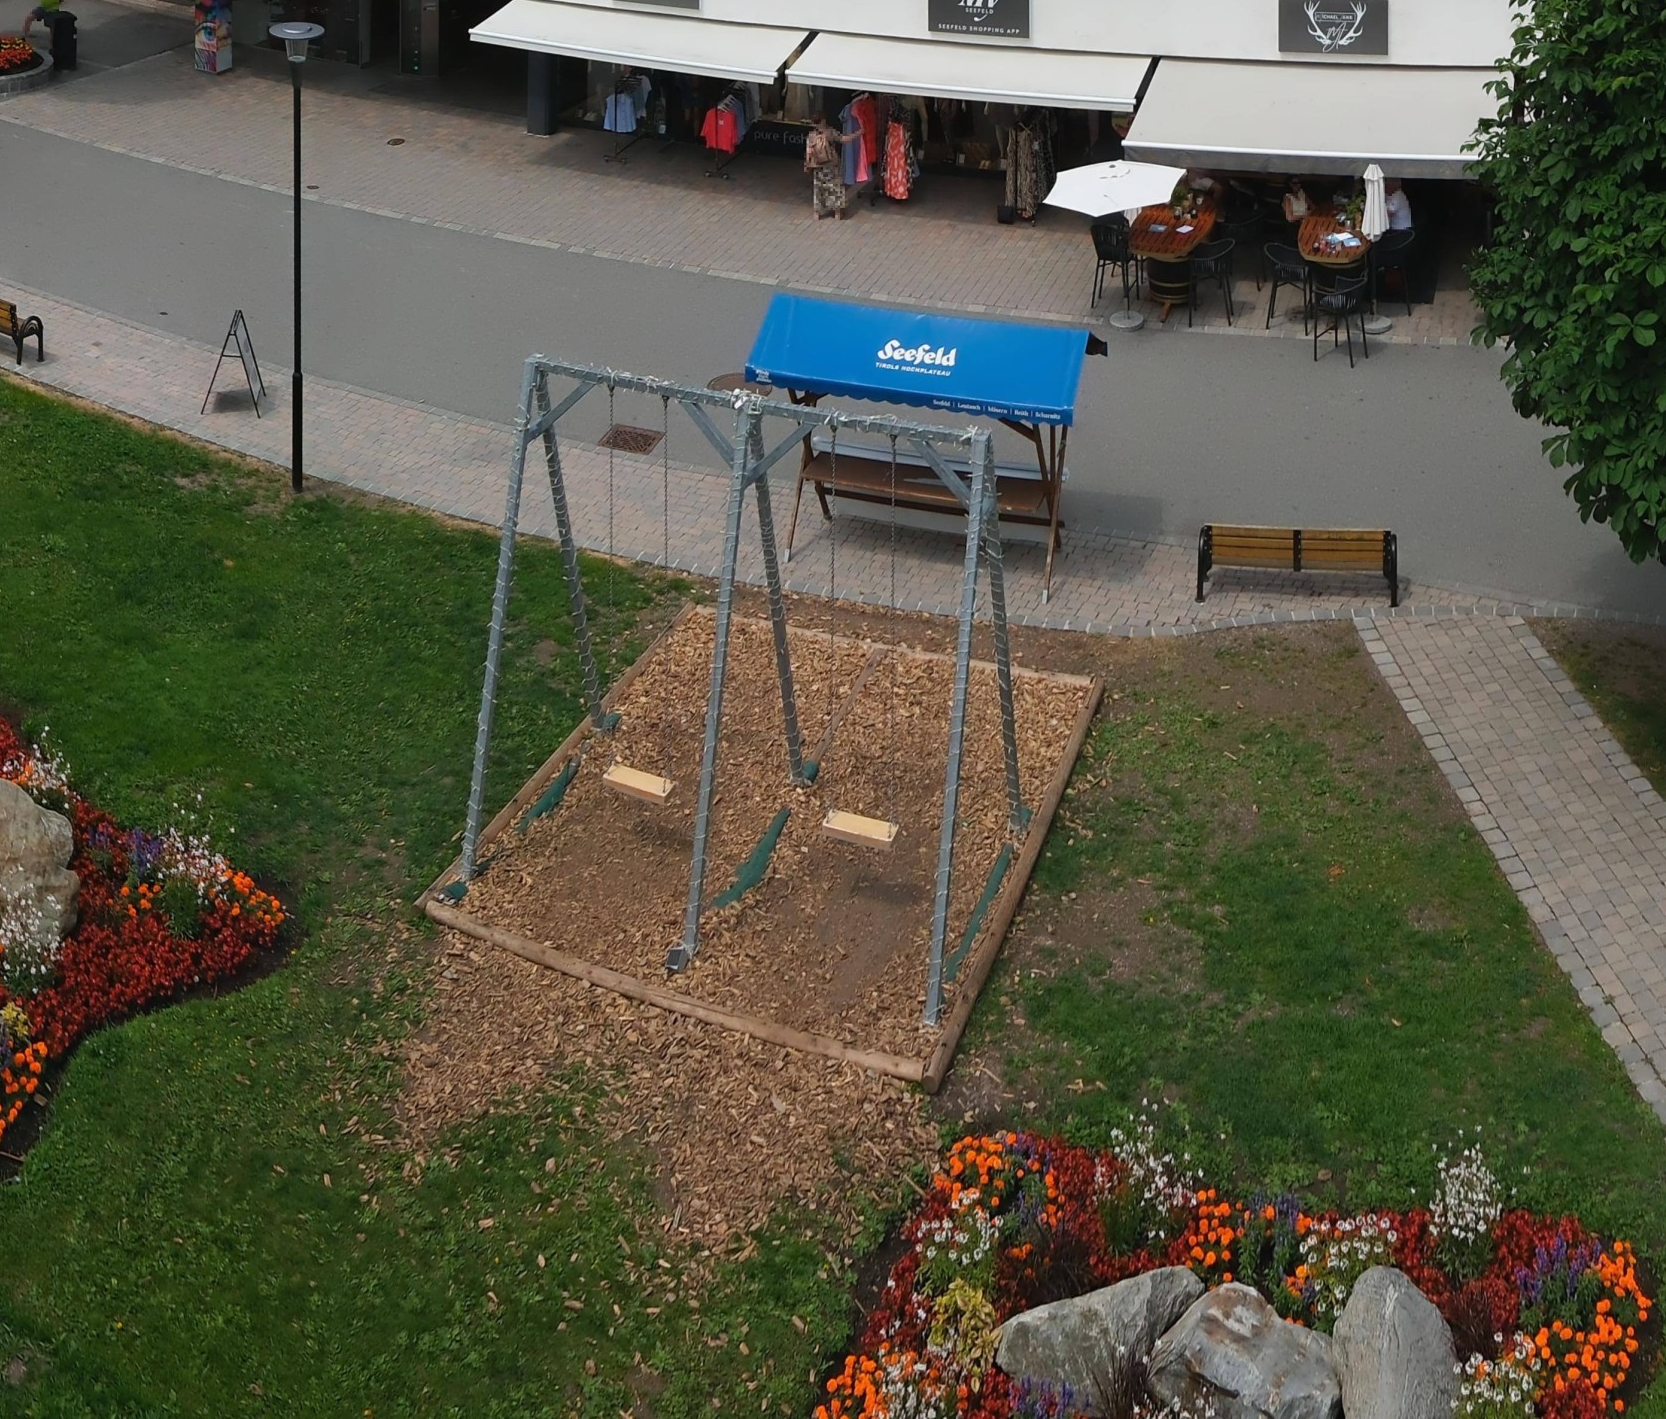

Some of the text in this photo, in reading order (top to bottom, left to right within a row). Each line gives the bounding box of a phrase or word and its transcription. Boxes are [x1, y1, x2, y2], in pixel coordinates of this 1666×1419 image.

[938, 23, 967, 31] SEEFELD
[969, 25, 1004, 34] SHOPPING
[754, 131, 780, 142] pure
[877, 339, 957, 367] Seefeld
[875, 362, 951, 377] TIROLS HOCHPLATEAU
